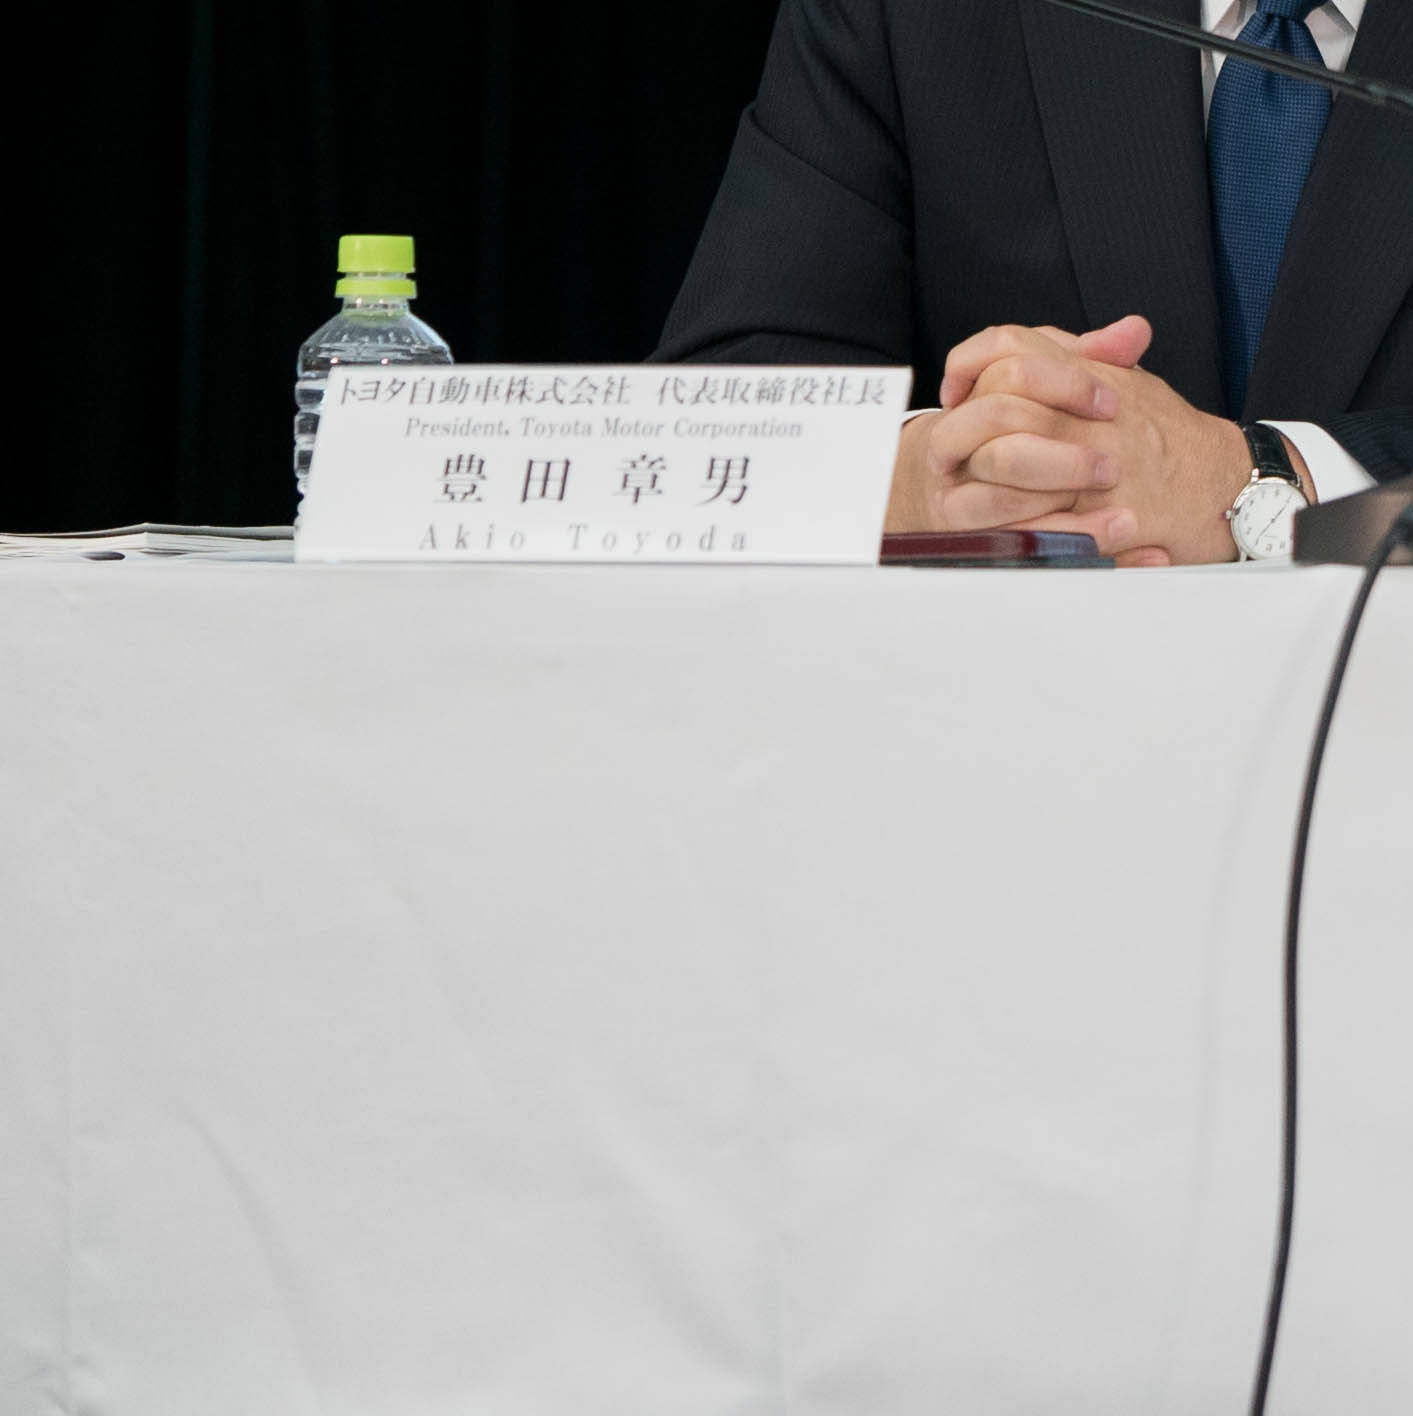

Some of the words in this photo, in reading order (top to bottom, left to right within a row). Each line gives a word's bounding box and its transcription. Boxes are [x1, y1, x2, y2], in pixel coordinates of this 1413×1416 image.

[340, 375, 631, 406] トヨタ自動車株式会社
[657, 374, 886, 406] 代表取締役社長
[520, 416, 593, 441] Toyota
[600, 416, 665, 438] Motor
[673, 415, 804, 441] Corporation
[418, 523, 526, 552] Akio
[567, 523, 748, 554] Toyoda
